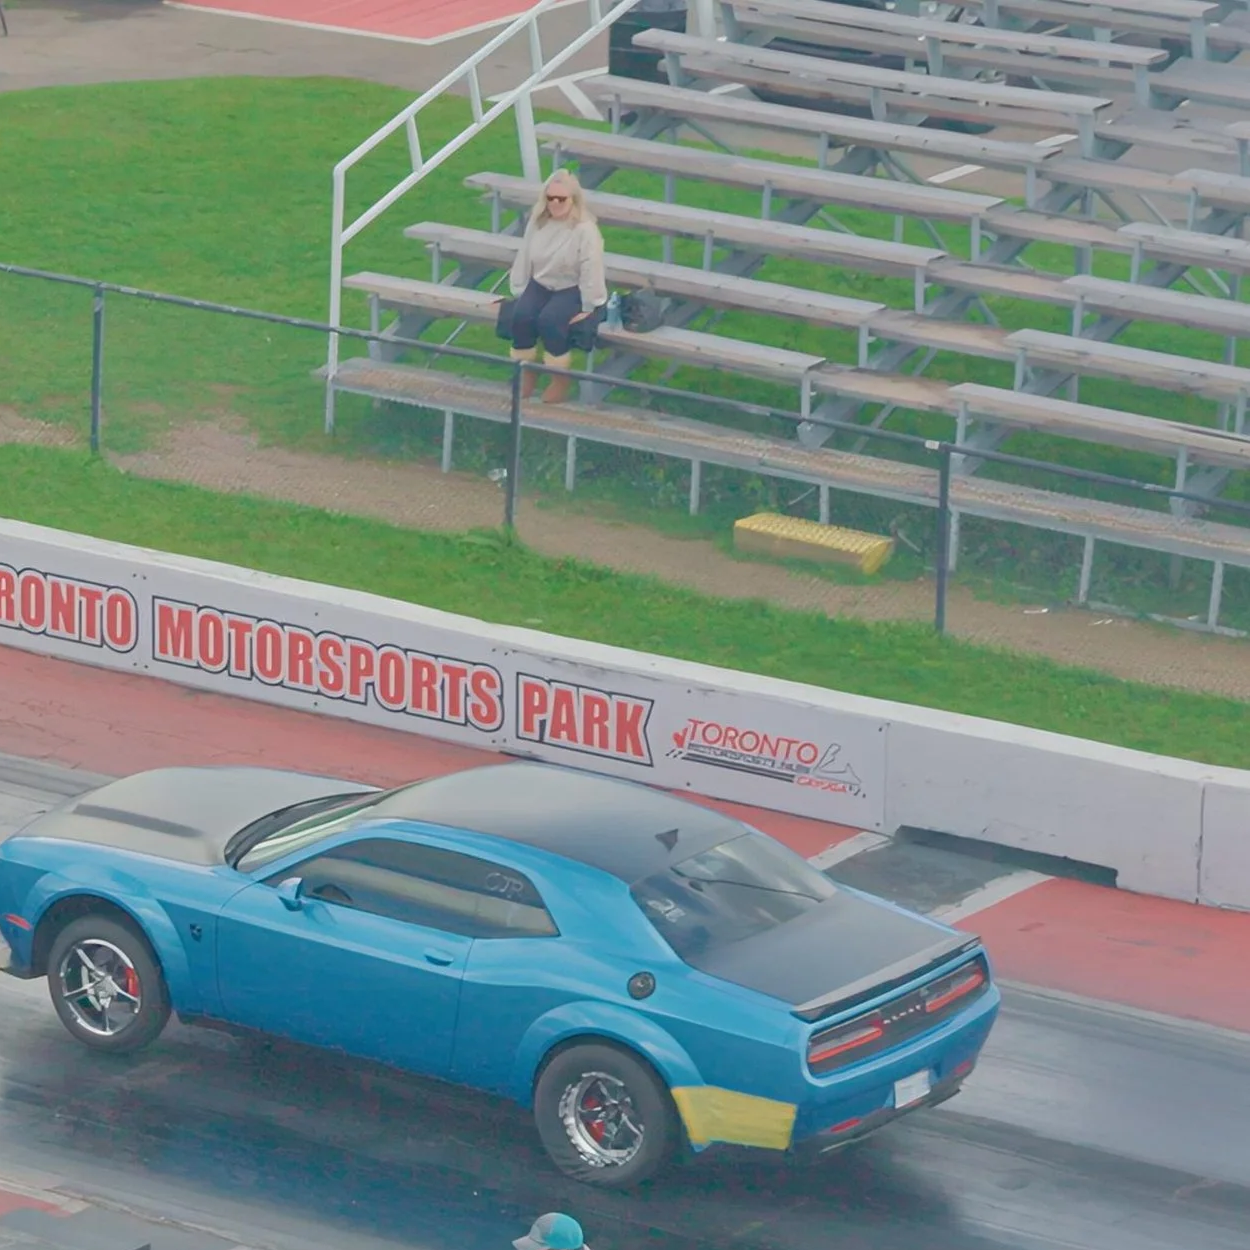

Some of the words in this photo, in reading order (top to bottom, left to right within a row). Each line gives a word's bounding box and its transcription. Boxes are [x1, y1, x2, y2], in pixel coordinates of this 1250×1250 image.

[153, 597, 504, 731] MOTORSPORTS
[517, 673, 654, 766] PARK
[687, 718, 819, 764] TORONTO
